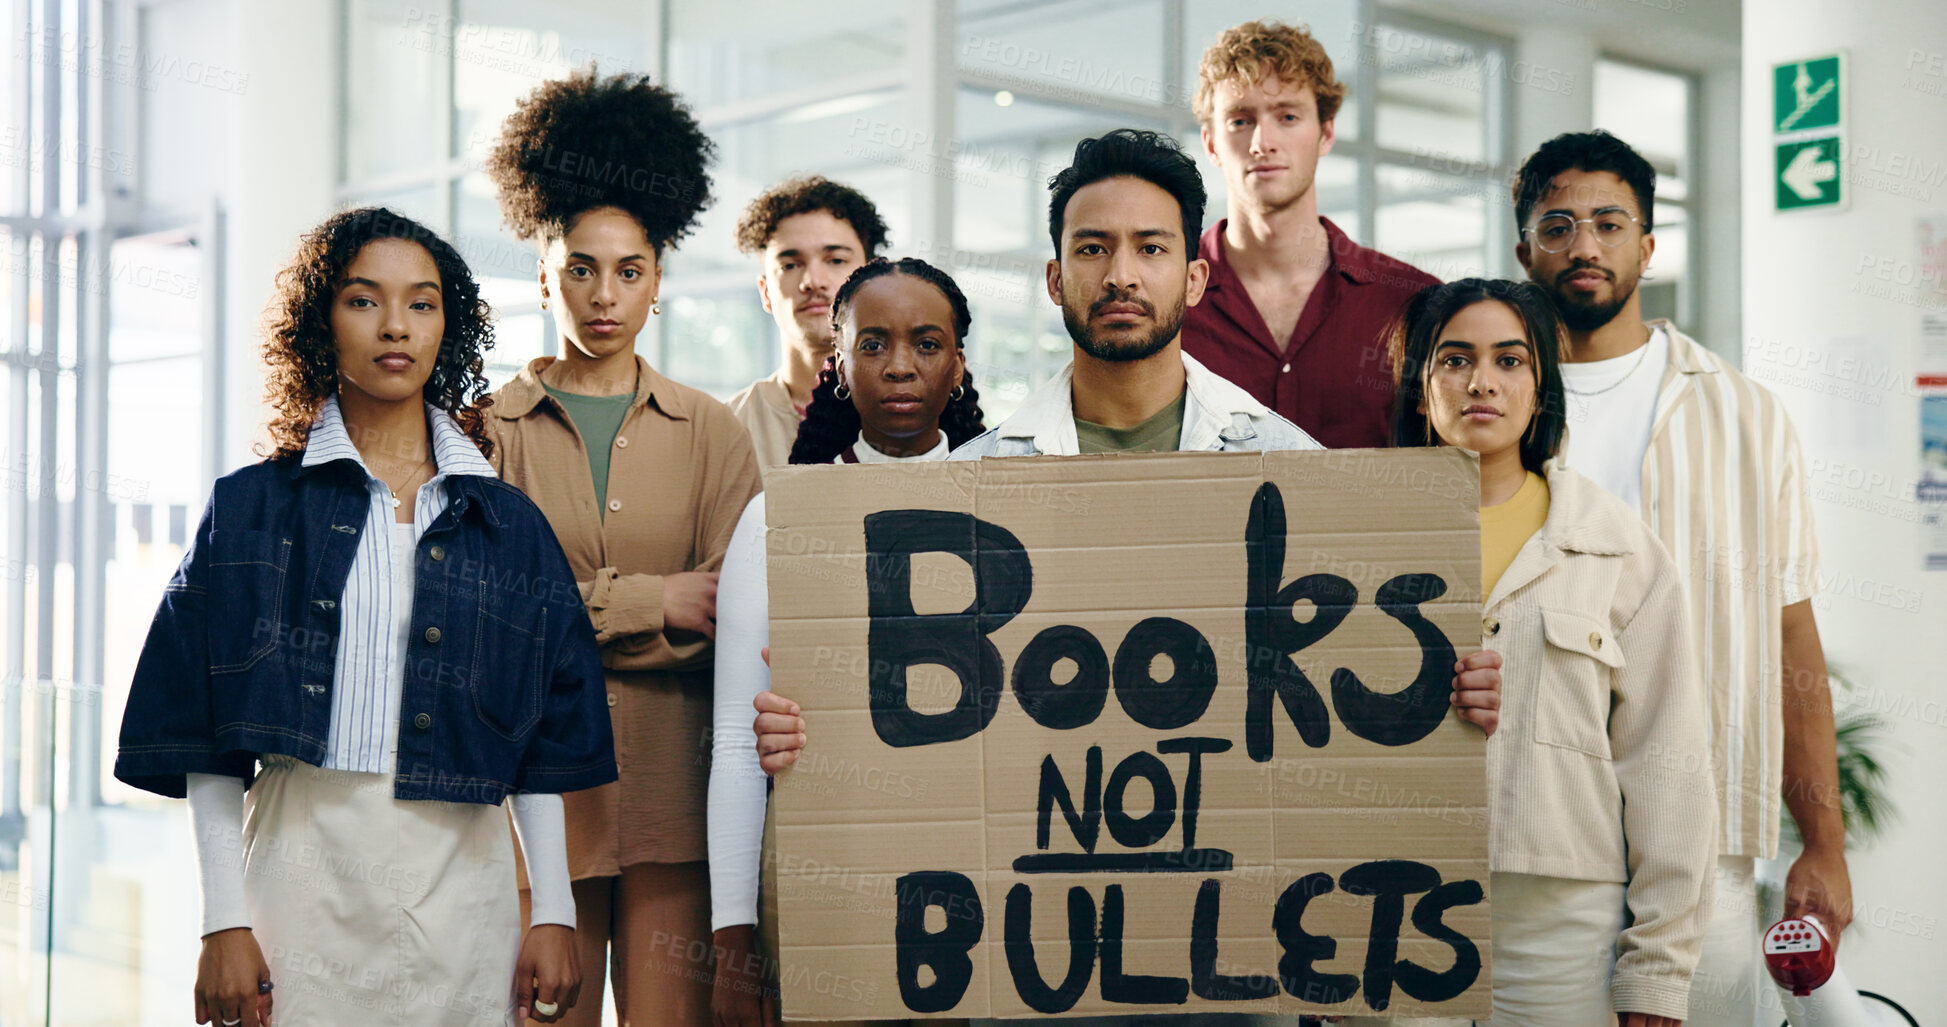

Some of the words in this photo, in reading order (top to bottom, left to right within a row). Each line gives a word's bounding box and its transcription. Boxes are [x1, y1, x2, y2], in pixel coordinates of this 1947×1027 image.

[864, 482, 1458, 762] Books
[1038, 737, 1233, 852] NOT
[895, 859, 1486, 1013] BULLETS
